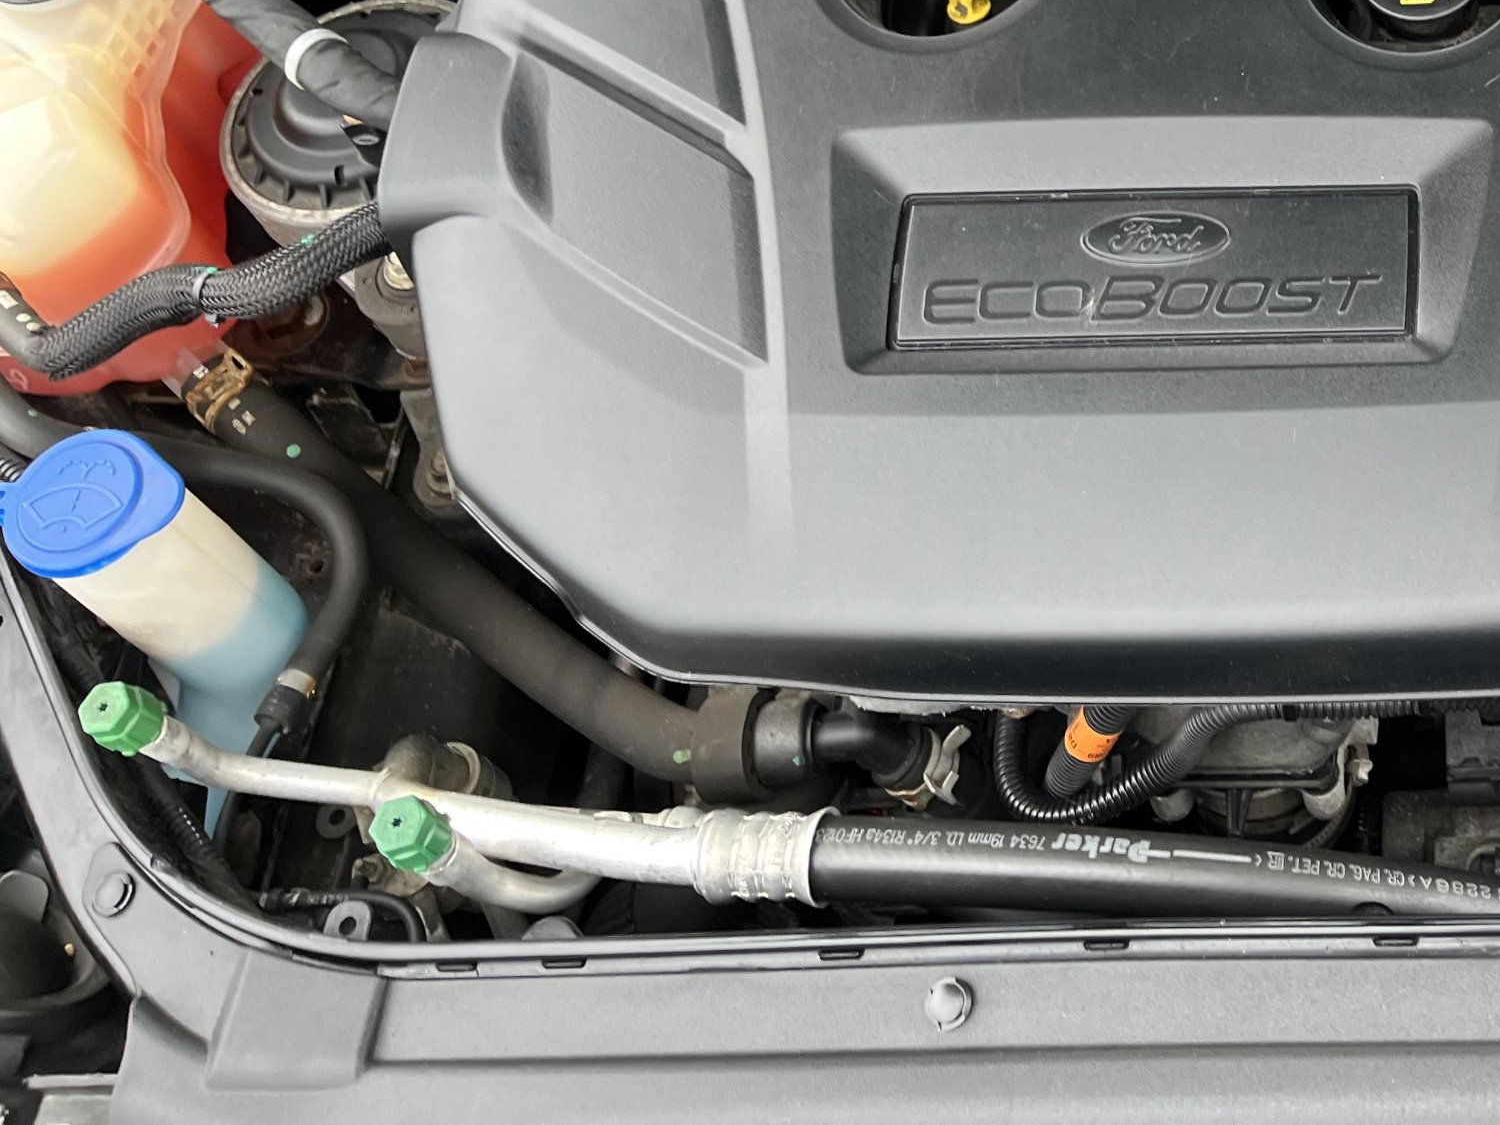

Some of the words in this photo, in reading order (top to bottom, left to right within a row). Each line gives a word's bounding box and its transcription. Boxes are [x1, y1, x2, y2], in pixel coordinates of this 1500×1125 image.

[1108, 216, 1201, 255] Ford
[923, 274, 1385, 326] ECOBOOST
[866, 827, 906, 846] R134a
[967, 831, 1005, 849] 19mm
[1010, 834, 1046, 851] 7634
[1050, 831, 1151, 864] Parker
